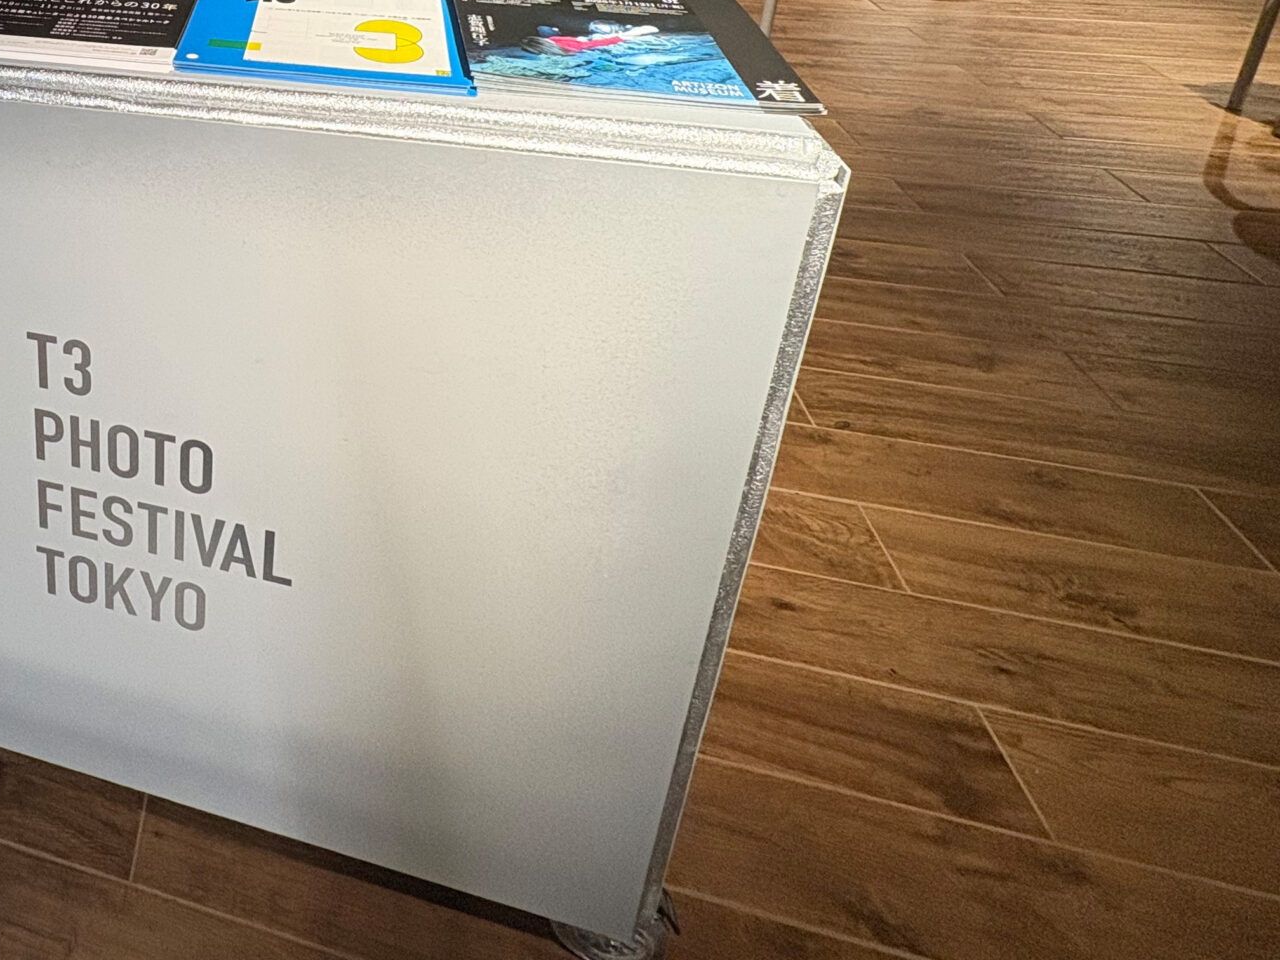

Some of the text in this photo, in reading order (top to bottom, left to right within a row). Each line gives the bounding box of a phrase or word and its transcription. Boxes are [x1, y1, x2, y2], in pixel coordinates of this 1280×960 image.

[671, 79, 741, 92] ARTIZON
[674, 86, 744, 97] MUSEUM
[756, 80, 806, 103] 着
[26, 330, 93, 397] T3
[33, 407, 214, 495] PHOTO
[36, 478, 293, 588] FESTIVAL
[34, 544, 207, 632] TOKYO
